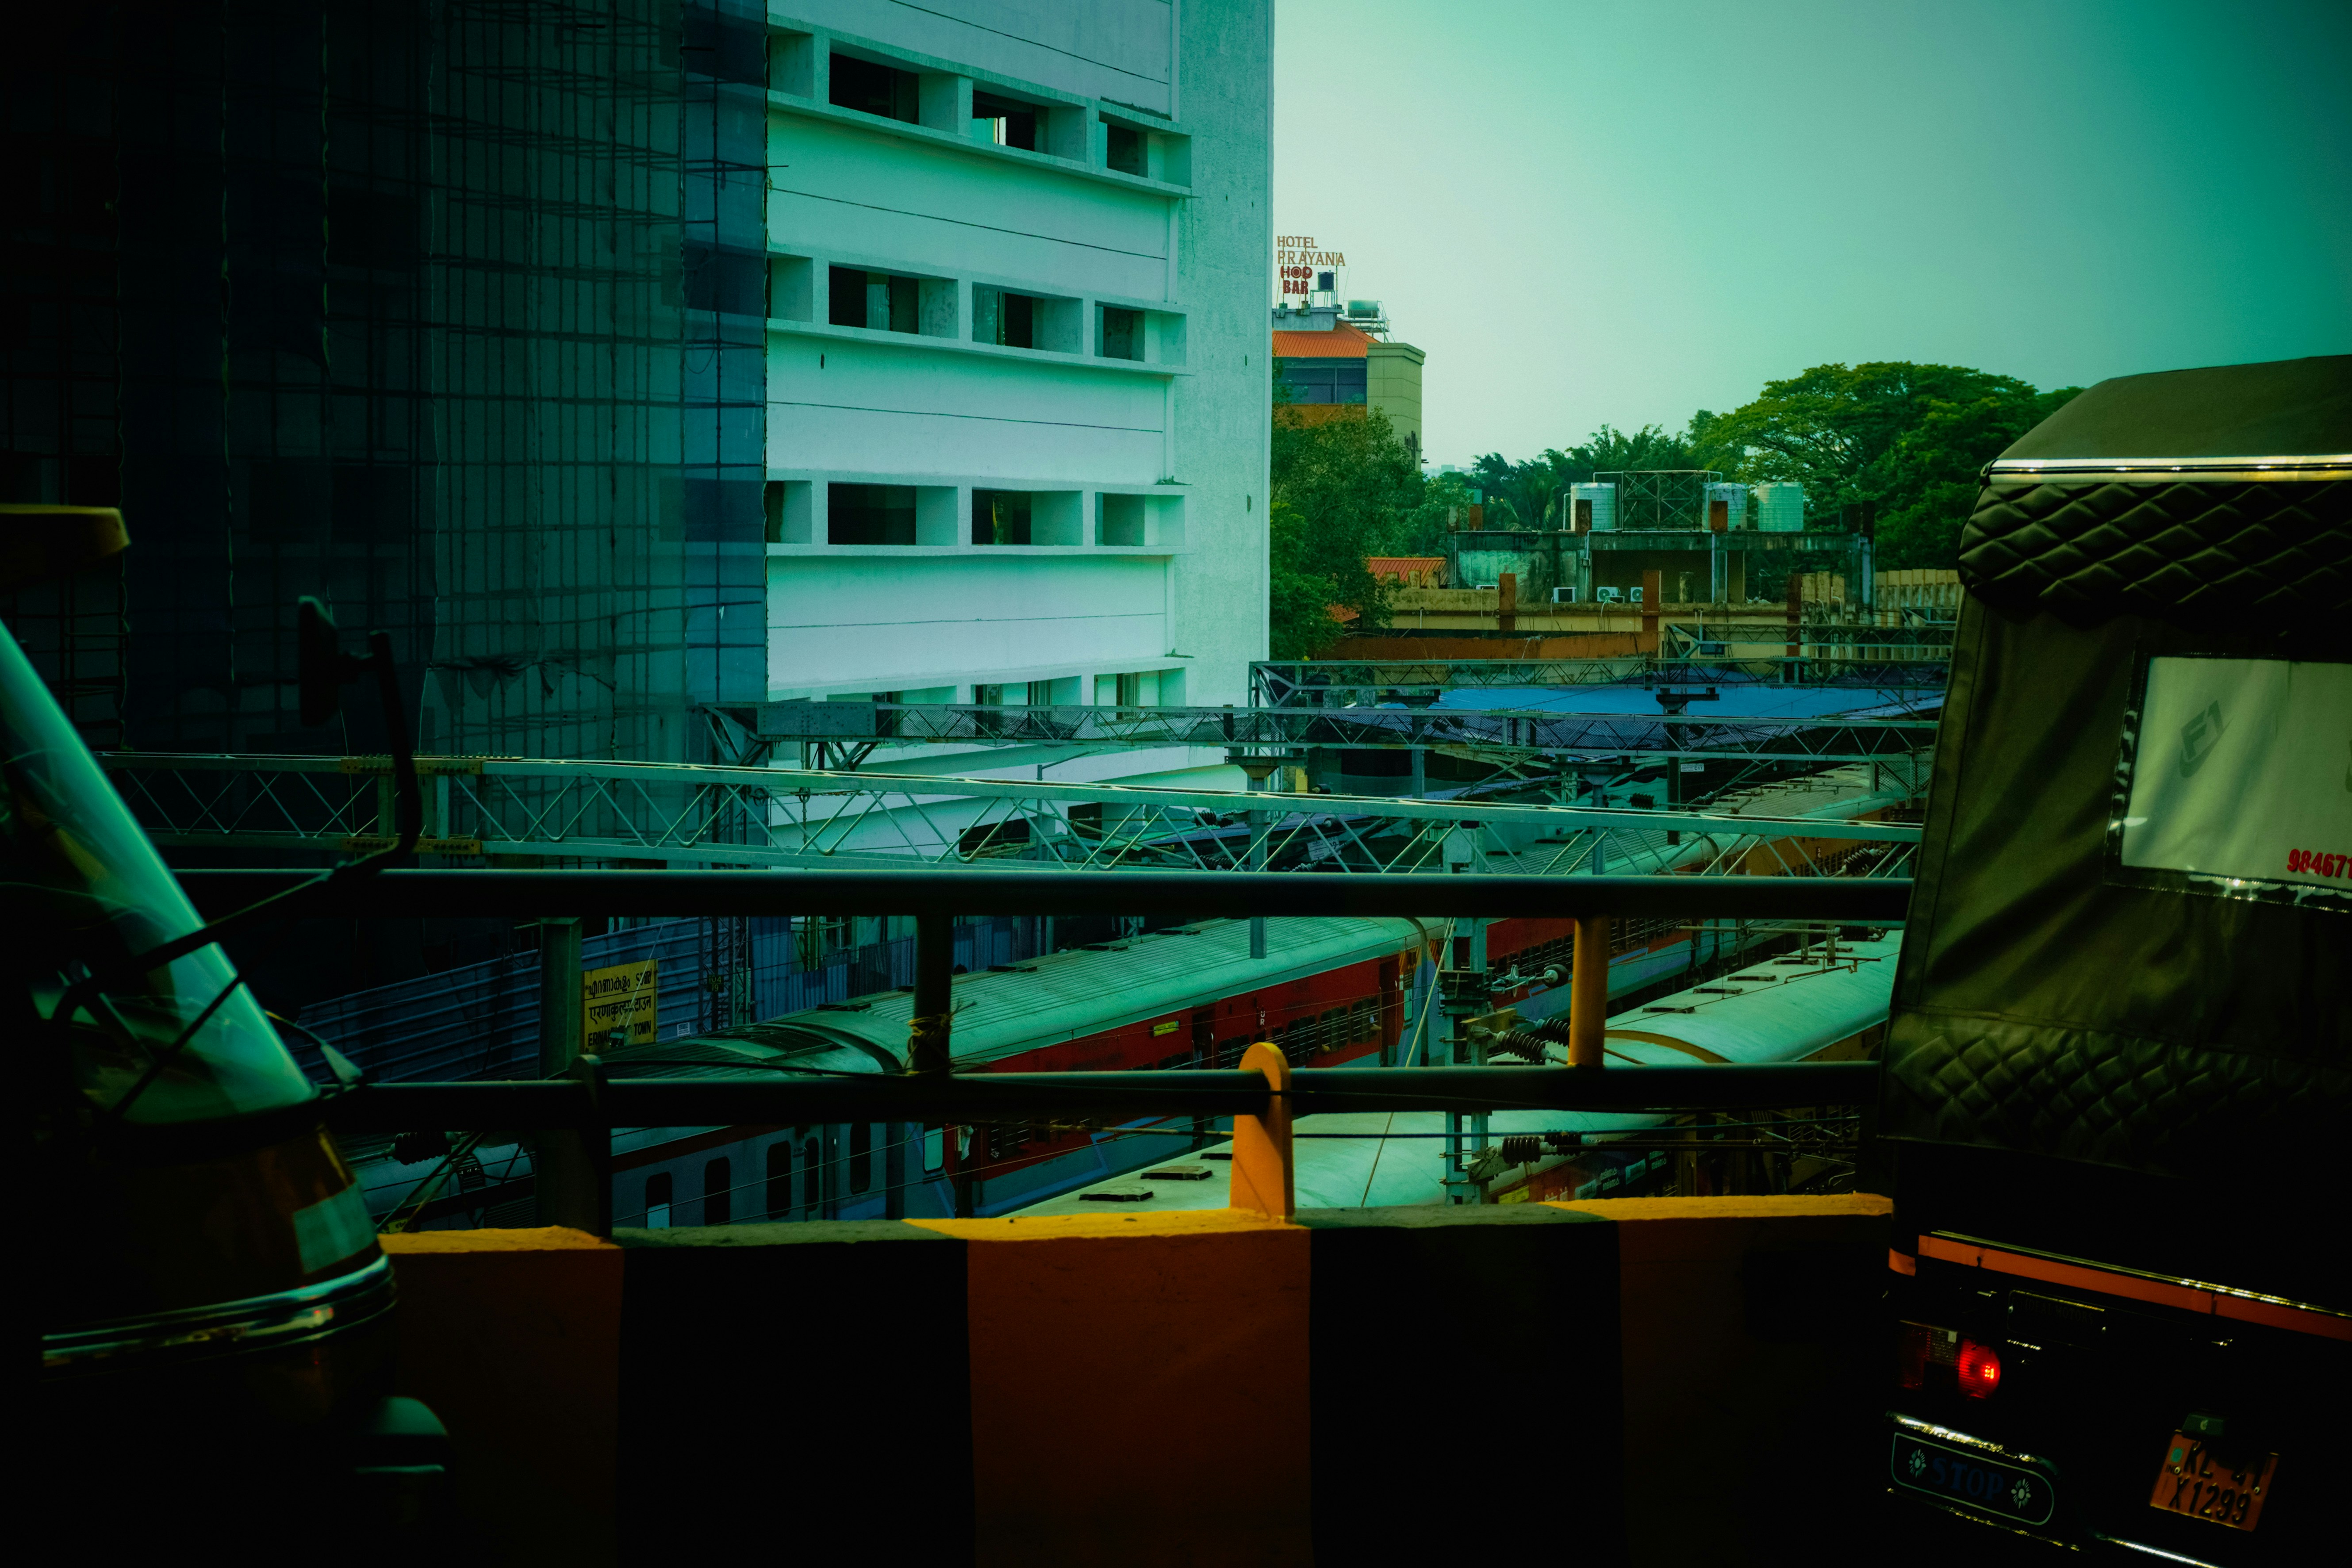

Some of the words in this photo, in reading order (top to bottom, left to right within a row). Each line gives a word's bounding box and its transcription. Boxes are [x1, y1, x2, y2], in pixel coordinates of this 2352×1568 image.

[1277, 236, 1318, 248] HOTEL
[1278, 250, 1346, 266] PRAYANA
[1283, 280, 1308, 294] BAR
[634, 1020, 651, 1036] TOWN
[1929, 1454, 2005, 1501] STOP
[2169, 1476, 2252, 1525] X1299
